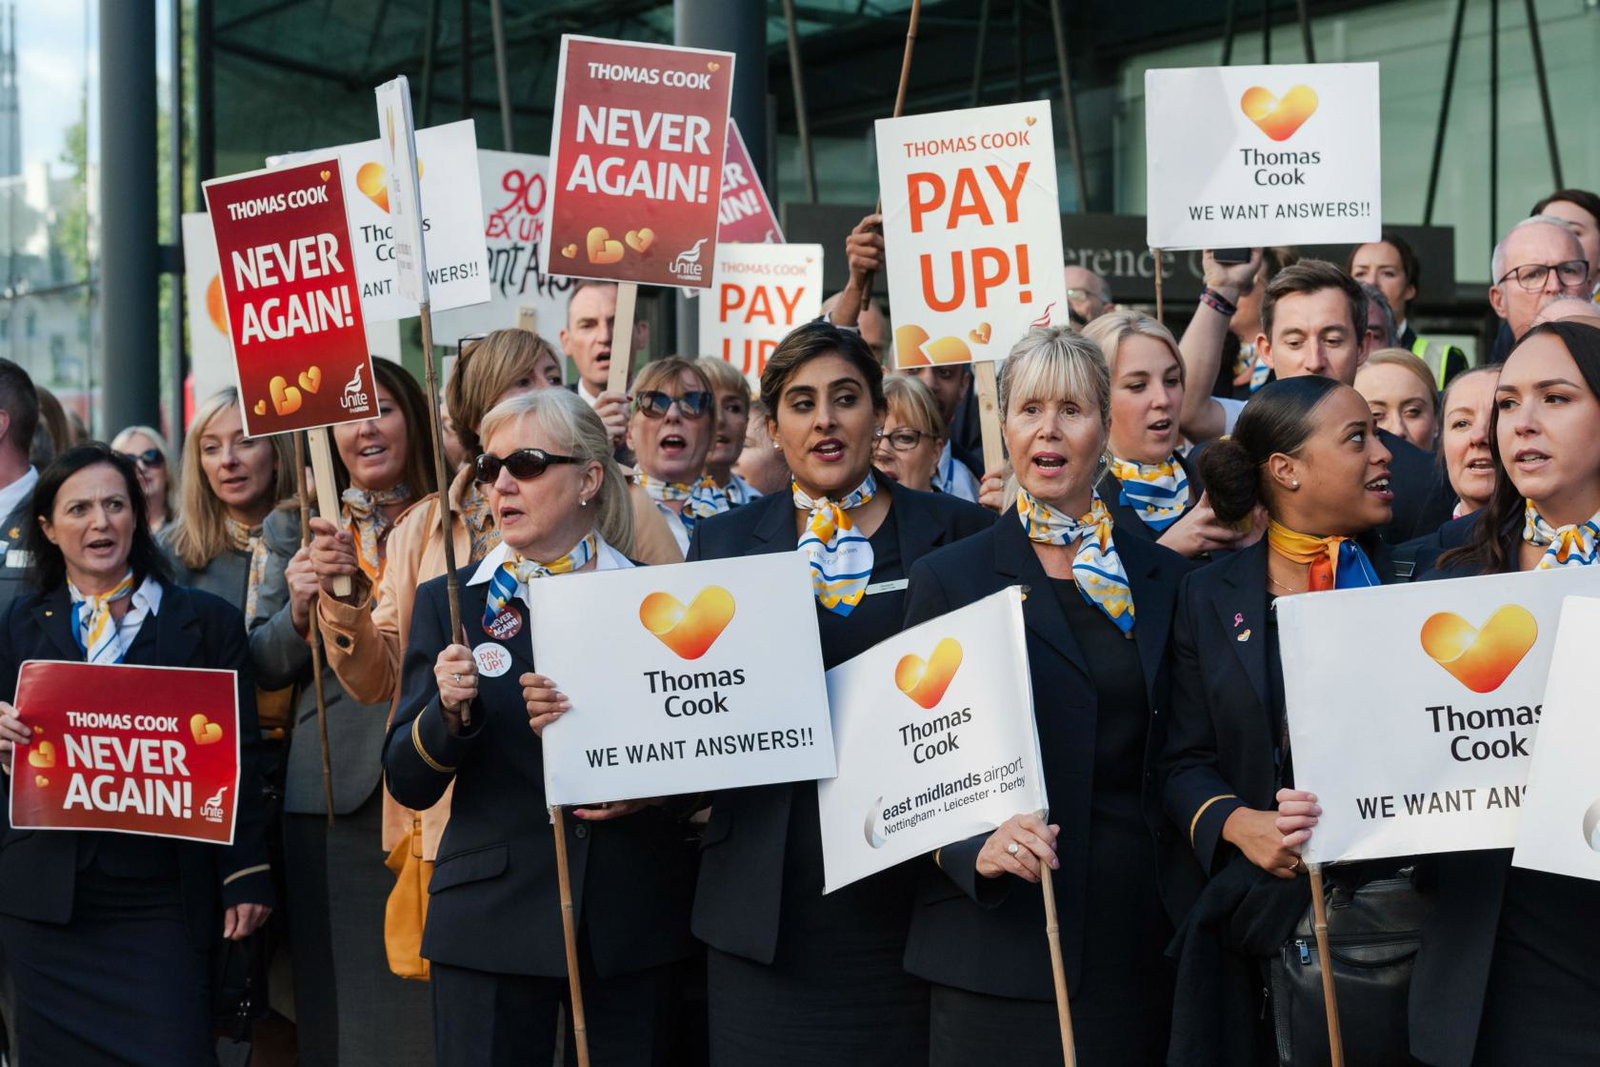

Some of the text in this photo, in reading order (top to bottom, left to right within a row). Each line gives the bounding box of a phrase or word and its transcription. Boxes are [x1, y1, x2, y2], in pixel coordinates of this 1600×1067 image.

[588, 62, 711, 90] THOMAS COOK
[576, 105, 711, 155] NEVER
[903, 130, 1031, 158] THOMAS COOK
[1240, 148, 1321, 166] Thomas
[566, 154, 710, 204] AGAIN!
[1254, 168, 1305, 186] Cook
[227, 185, 329, 221] THOMAS COOK
[907, 161, 1031, 233] PAY
[1189, 201, 1371, 221] WE WANT ANSWERS!!
[360, 218, 431, 243] Thos
[231, 232, 345, 292] NEVER
[363, 260, 479, 298] ANT WERS!!
[721, 262, 806, 277] THOMAS COOK
[920, 243, 1033, 313] UP!
[242, 285, 354, 345] AGAIN!
[720, 283, 805, 325] PAY
[479, 650, 501, 662] PAY
[483, 659, 504, 671] UP!
[643, 668, 746, 693] Thomas
[664, 691, 729, 717] Cook
[66, 711, 179, 733] THOMAS COOK
[899, 707, 972, 746] Thomas
[63, 734, 191, 777] NEVER
[586, 727, 814, 768] WE WANT ANSWERS!!
[913, 731, 960, 764] Cook
[1450, 731, 1530, 762] Cook
[62, 773, 192, 819] AGAIN!
[882, 756, 1024, 821] east midlands airport
[1356, 796, 1396, 820] WE
[1403, 788, 1477, 816] WANT
[884, 775, 1025, 837] Nottingham Leicester Derby
